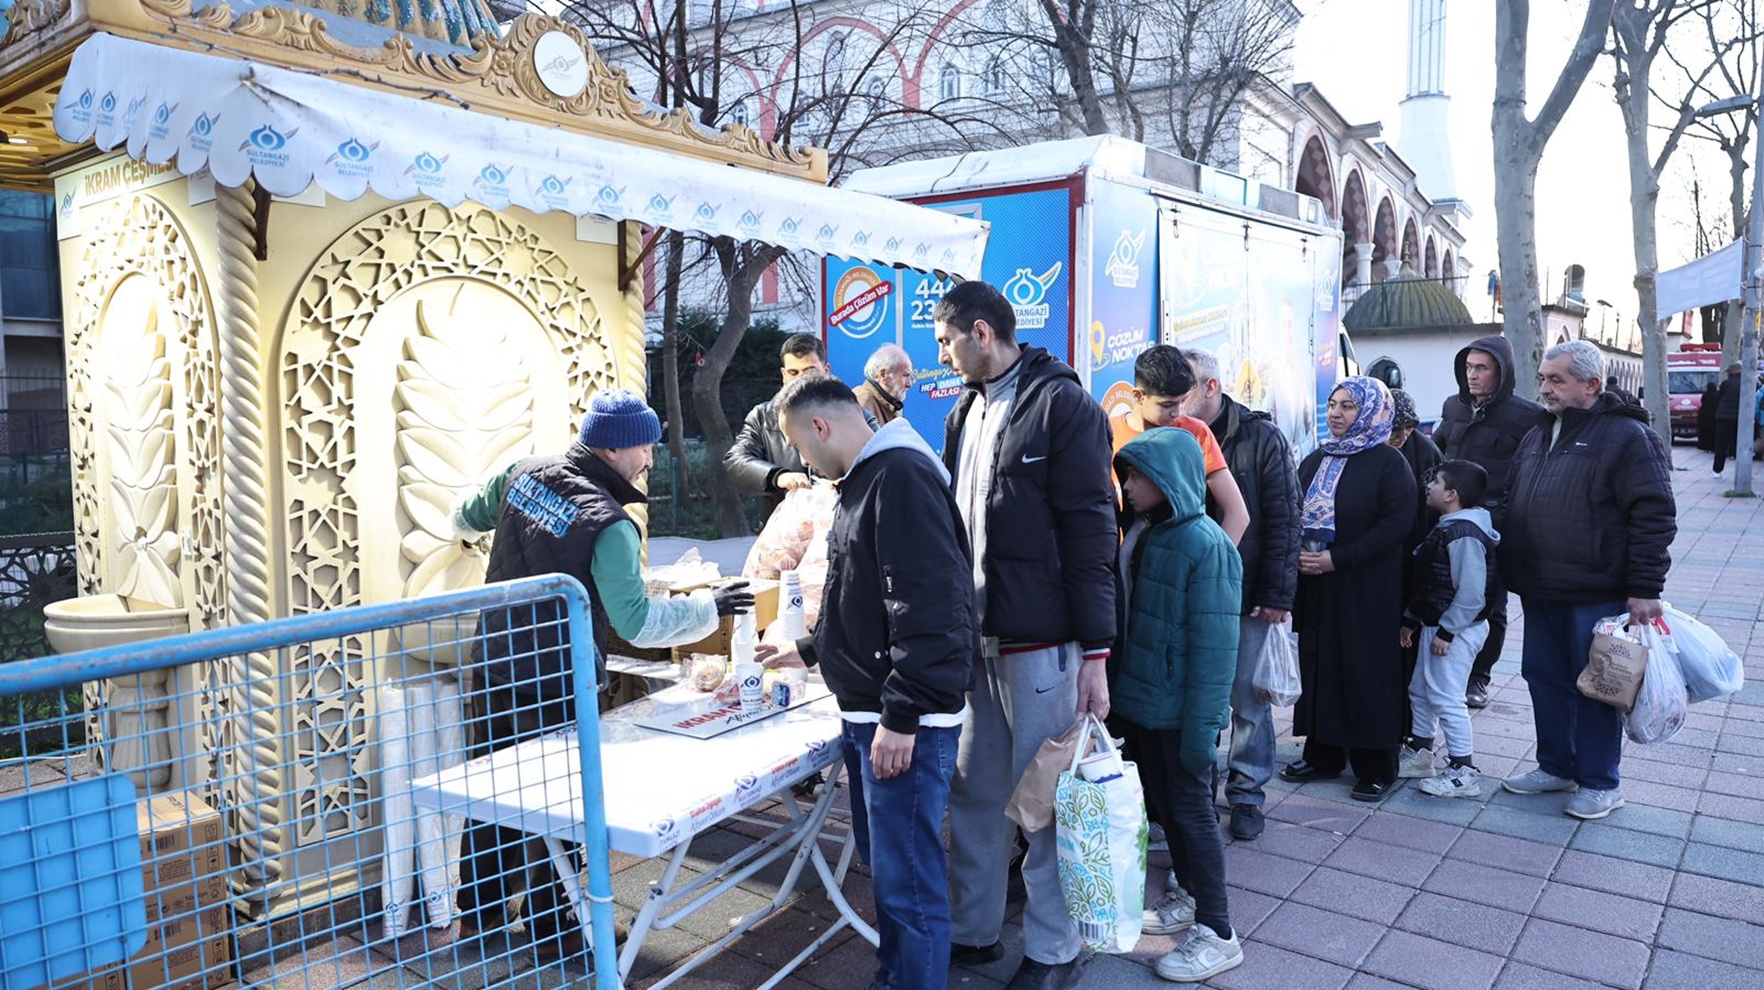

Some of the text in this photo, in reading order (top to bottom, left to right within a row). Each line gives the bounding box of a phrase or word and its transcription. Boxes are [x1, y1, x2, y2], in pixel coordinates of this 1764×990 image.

[830, 304, 855, 325] Burada
[876, 284, 889, 296] Var
[1014, 305, 1048, 317] TANGAZİ
[920, 382, 936, 392] HEP
[931, 386, 960, 398] FAZLASI
